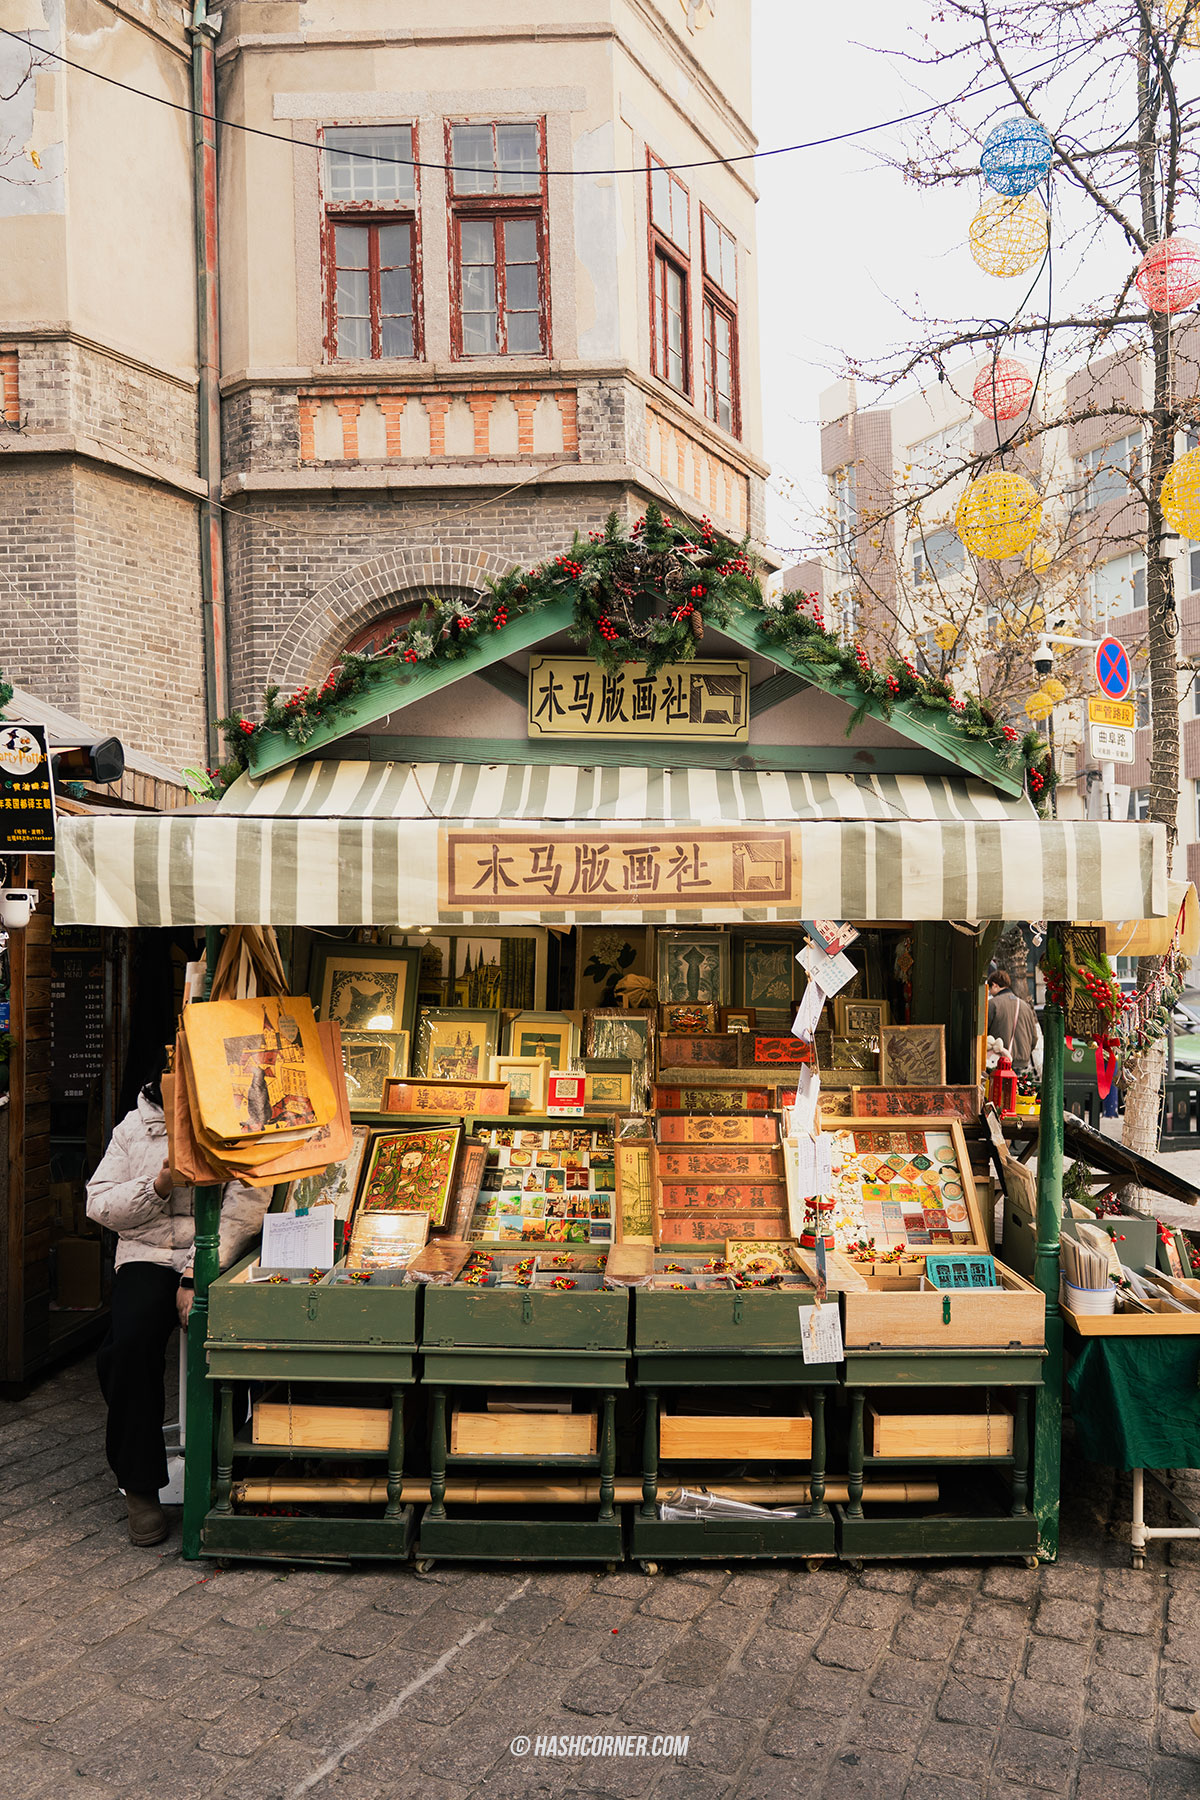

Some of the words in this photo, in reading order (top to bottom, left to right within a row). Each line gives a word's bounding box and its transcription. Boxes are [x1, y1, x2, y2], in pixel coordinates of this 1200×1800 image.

[533, 669, 690, 725] 木马版画社
[1094, 703, 1131, 721] 严管路段
[1098, 730, 1126, 747] 曲阜路
[0, 751, 17, 764] arry
[17, 750, 48, 767] Potter
[472, 842, 712, 896] 木马版画社
[684, 1186, 699, 1208] 馬上
